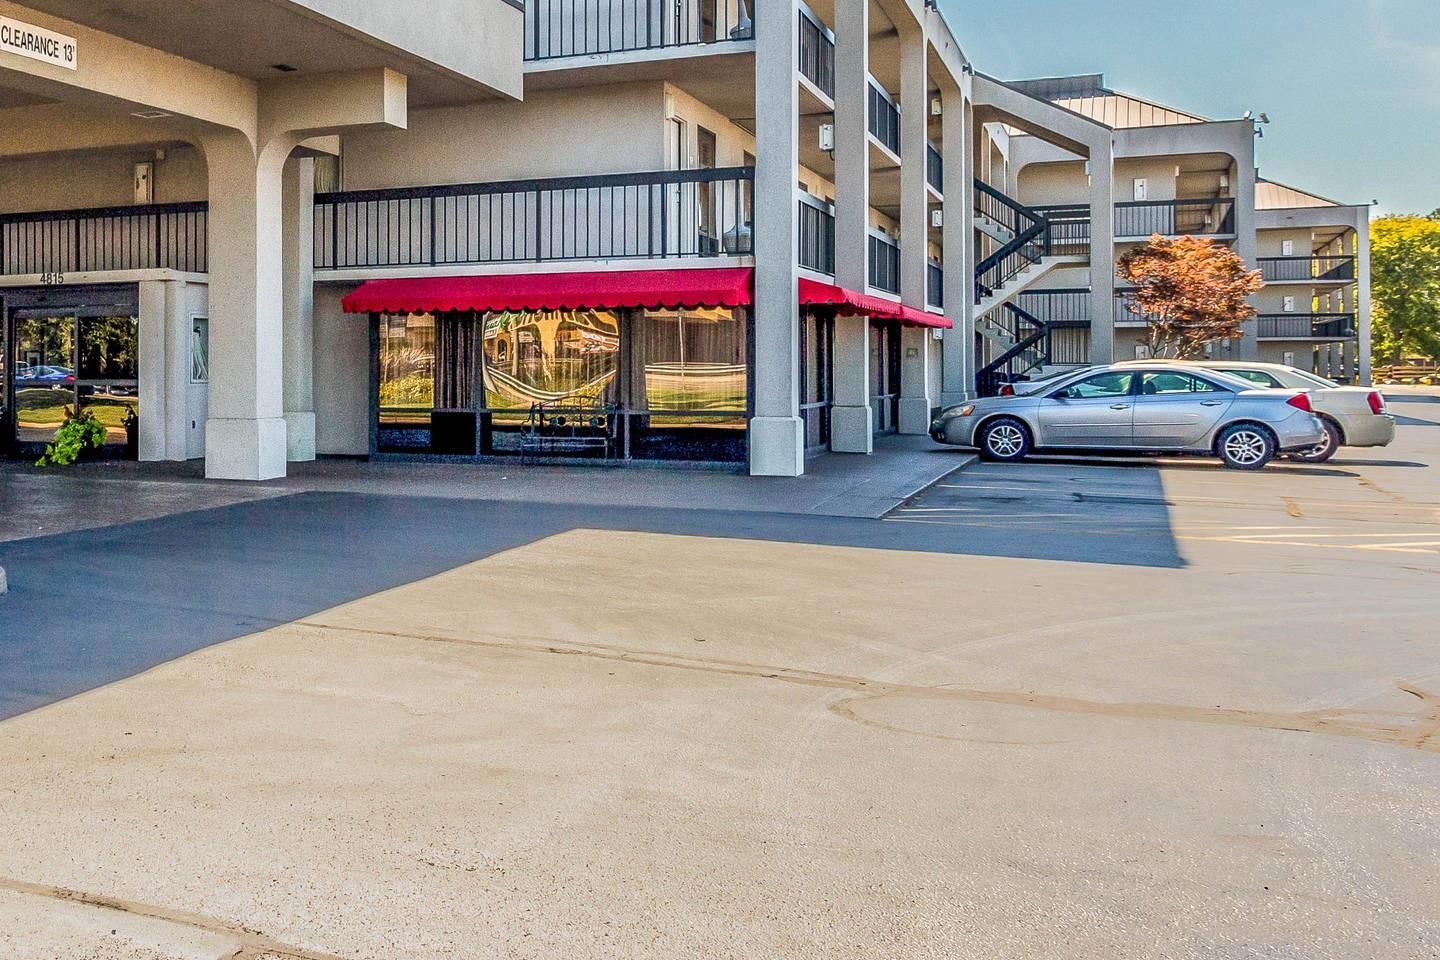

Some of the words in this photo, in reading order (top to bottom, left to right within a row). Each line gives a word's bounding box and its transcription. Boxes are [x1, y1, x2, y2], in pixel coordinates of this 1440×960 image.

[1, 25, 59, 58] CLEARANCE
[63, 43, 75, 62] 13'
[40, 272, 64, 285] 4815
